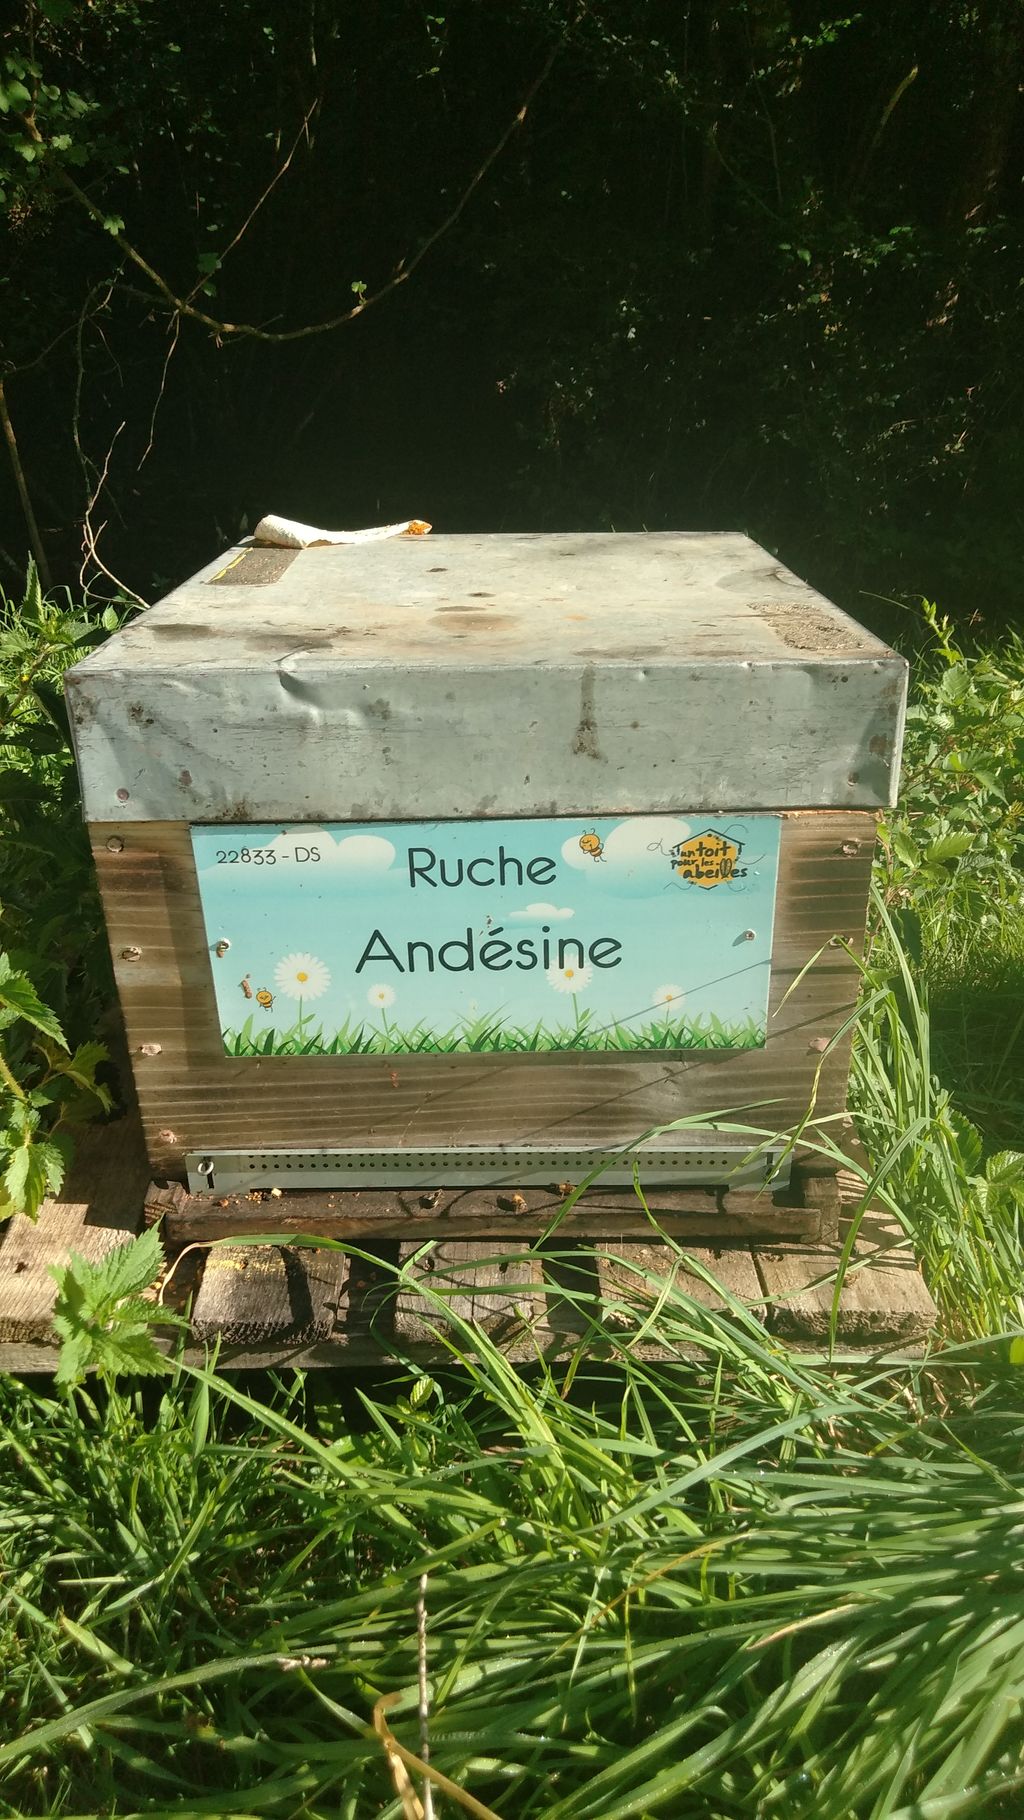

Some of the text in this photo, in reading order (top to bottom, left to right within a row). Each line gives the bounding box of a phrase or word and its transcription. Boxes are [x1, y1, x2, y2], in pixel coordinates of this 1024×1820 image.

[215, 847, 277, 866] 22833
[294, 846, 321, 863] DS
[680, 841, 731, 858] un toit
[408, 846, 557, 888] Ruche
[670, 857, 714, 870] pour les
[683, 858, 748, 879] abeilles
[355, 925, 622, 973] Andésine
